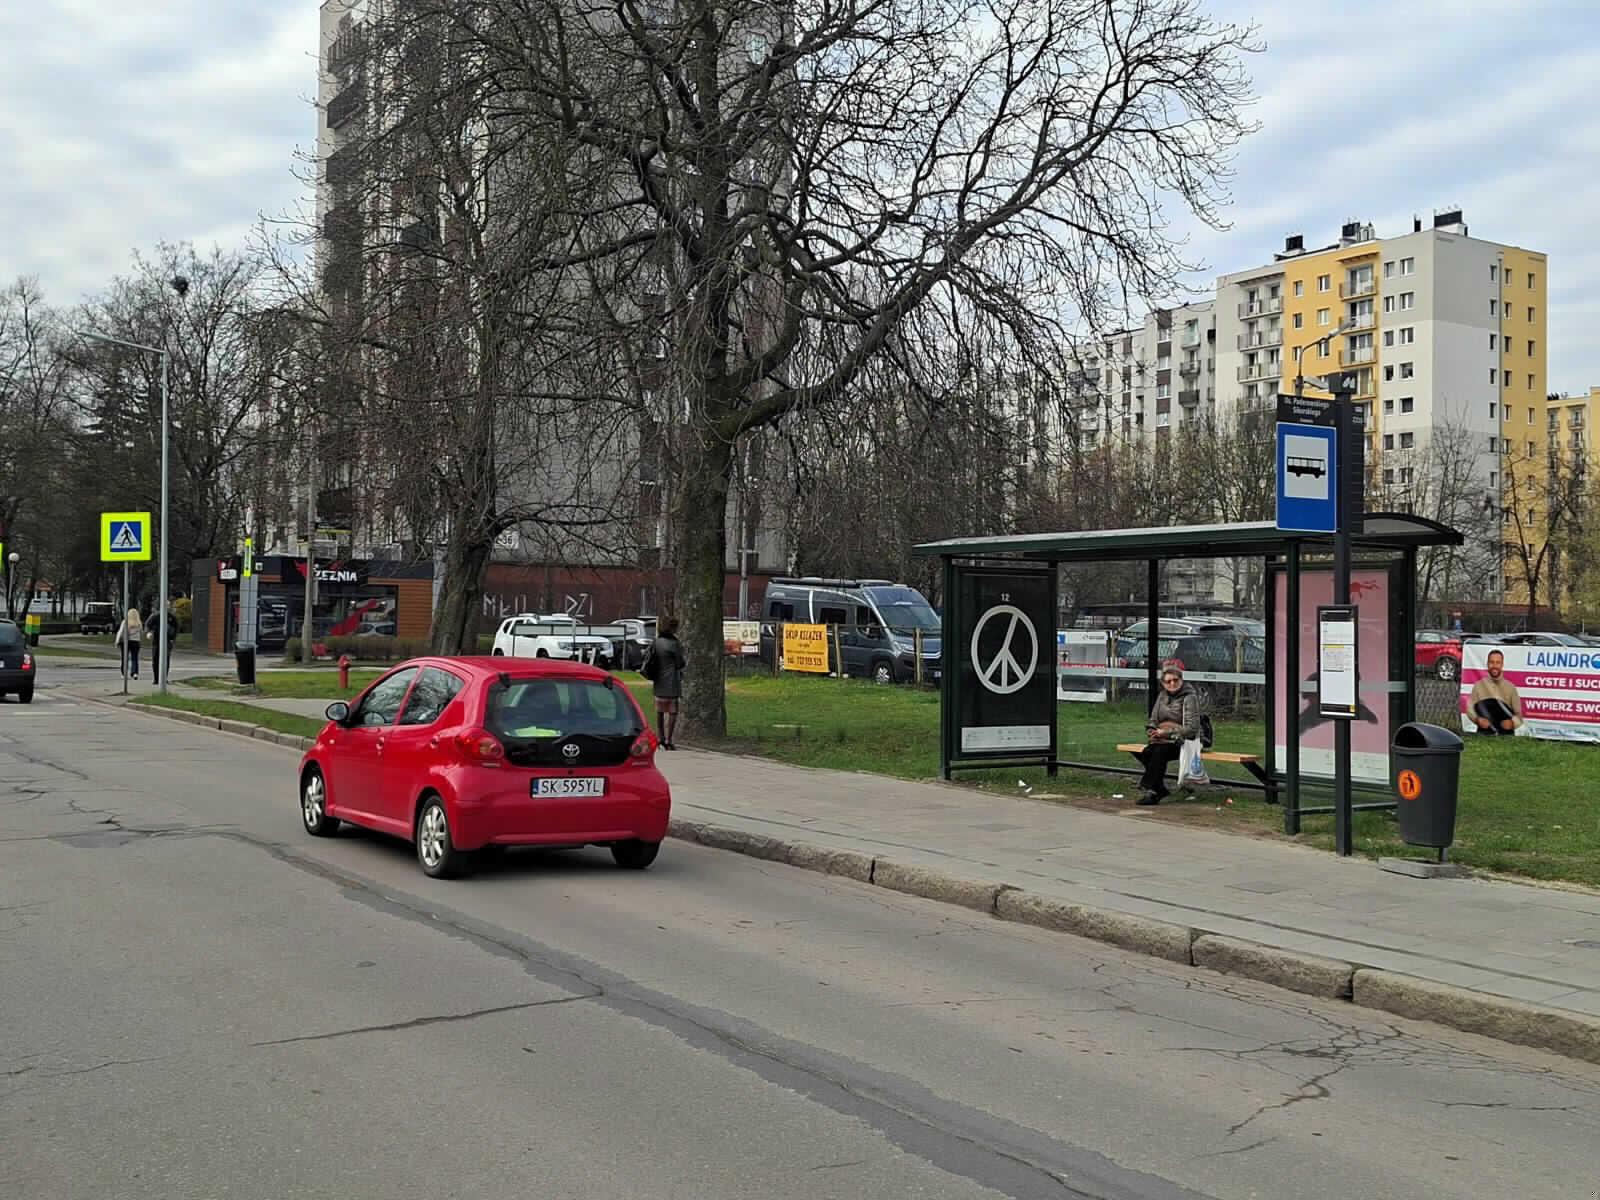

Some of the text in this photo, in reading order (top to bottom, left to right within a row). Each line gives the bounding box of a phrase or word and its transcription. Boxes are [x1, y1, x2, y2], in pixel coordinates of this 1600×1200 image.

[1001, 593, 1010, 602] 12
[1525, 676, 1600, 689] CZYSTE I SUC
[1525, 699, 1573, 712] WYPIERZ
[542, 779, 600, 793] SK 595YL
